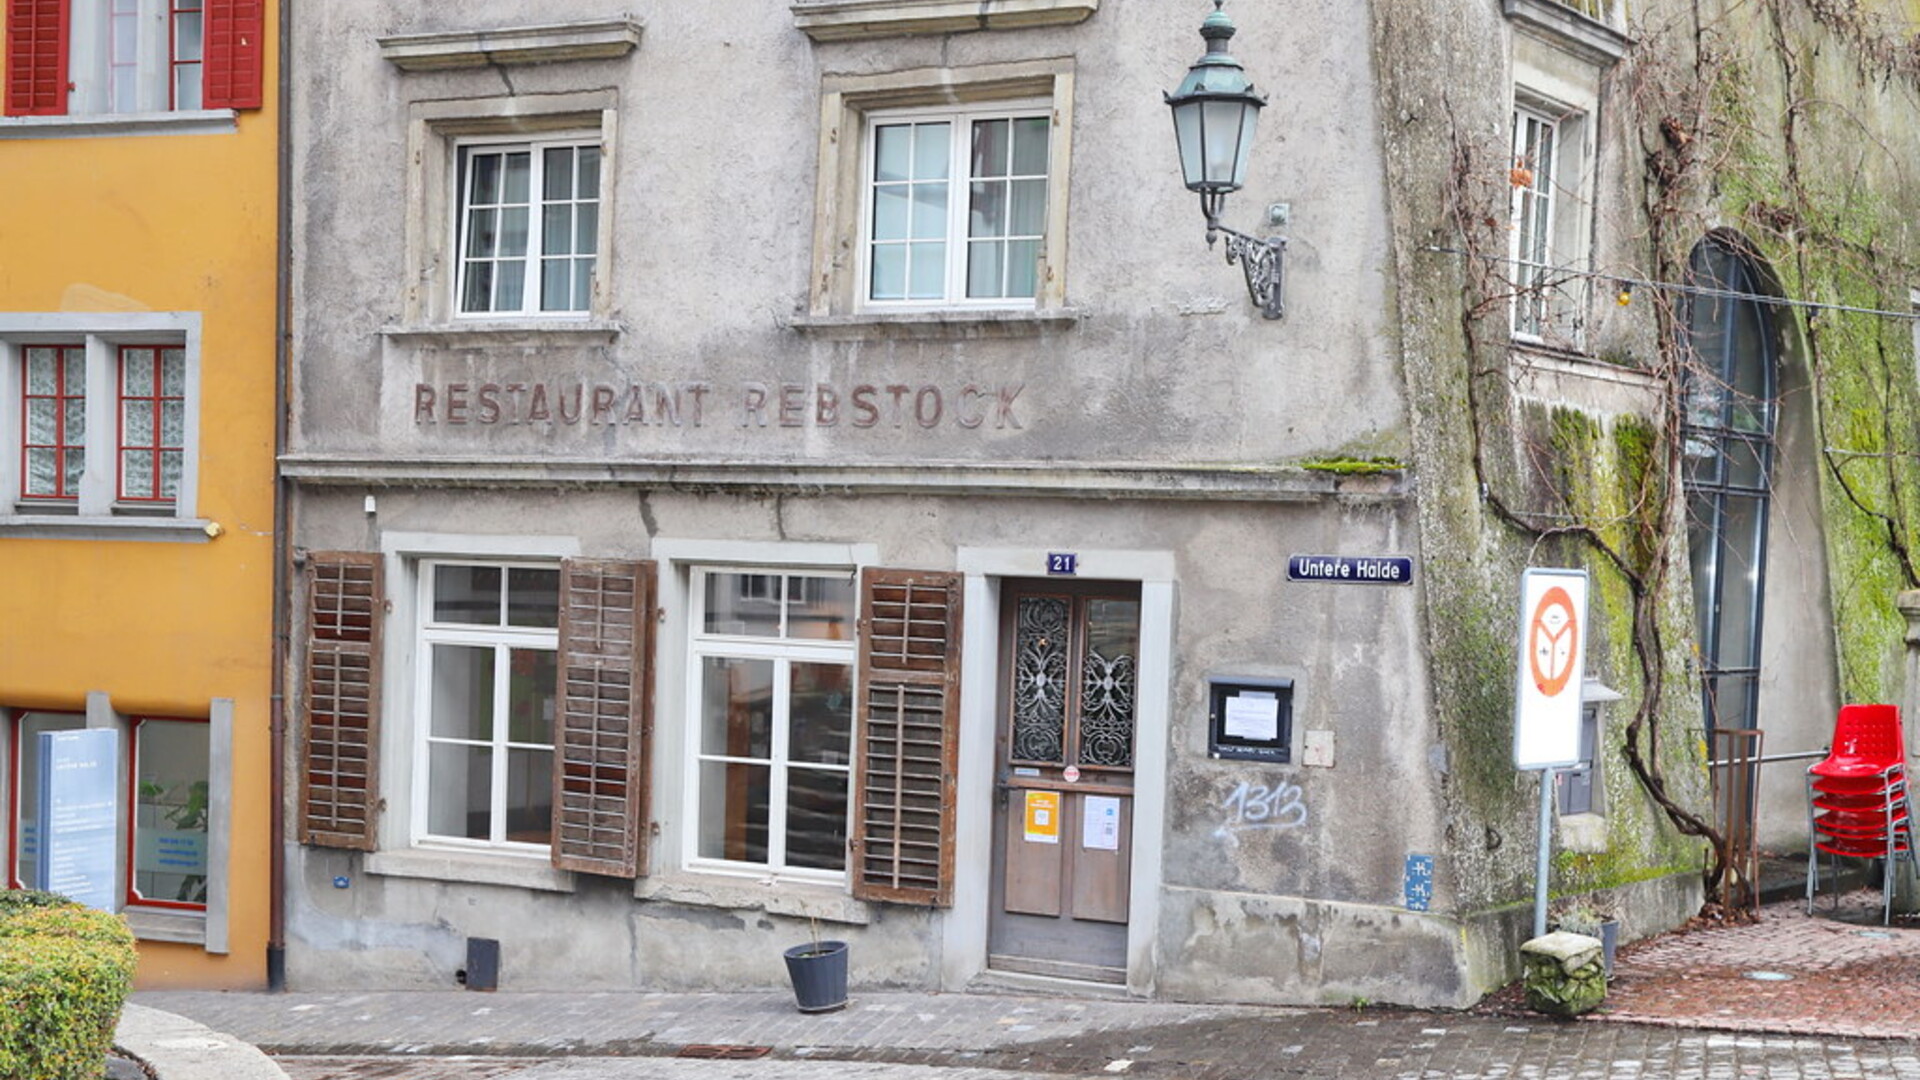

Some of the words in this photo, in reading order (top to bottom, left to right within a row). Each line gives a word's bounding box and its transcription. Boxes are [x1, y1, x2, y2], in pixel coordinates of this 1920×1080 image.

[413, 382, 711, 427] RESTAURANT
[739, 381, 1026, 430] REBSTOCK
[1053, 555, 1070, 571] 21
[1299, 558, 1350, 578] Untere
[1356, 559, 1400, 579] Halde
